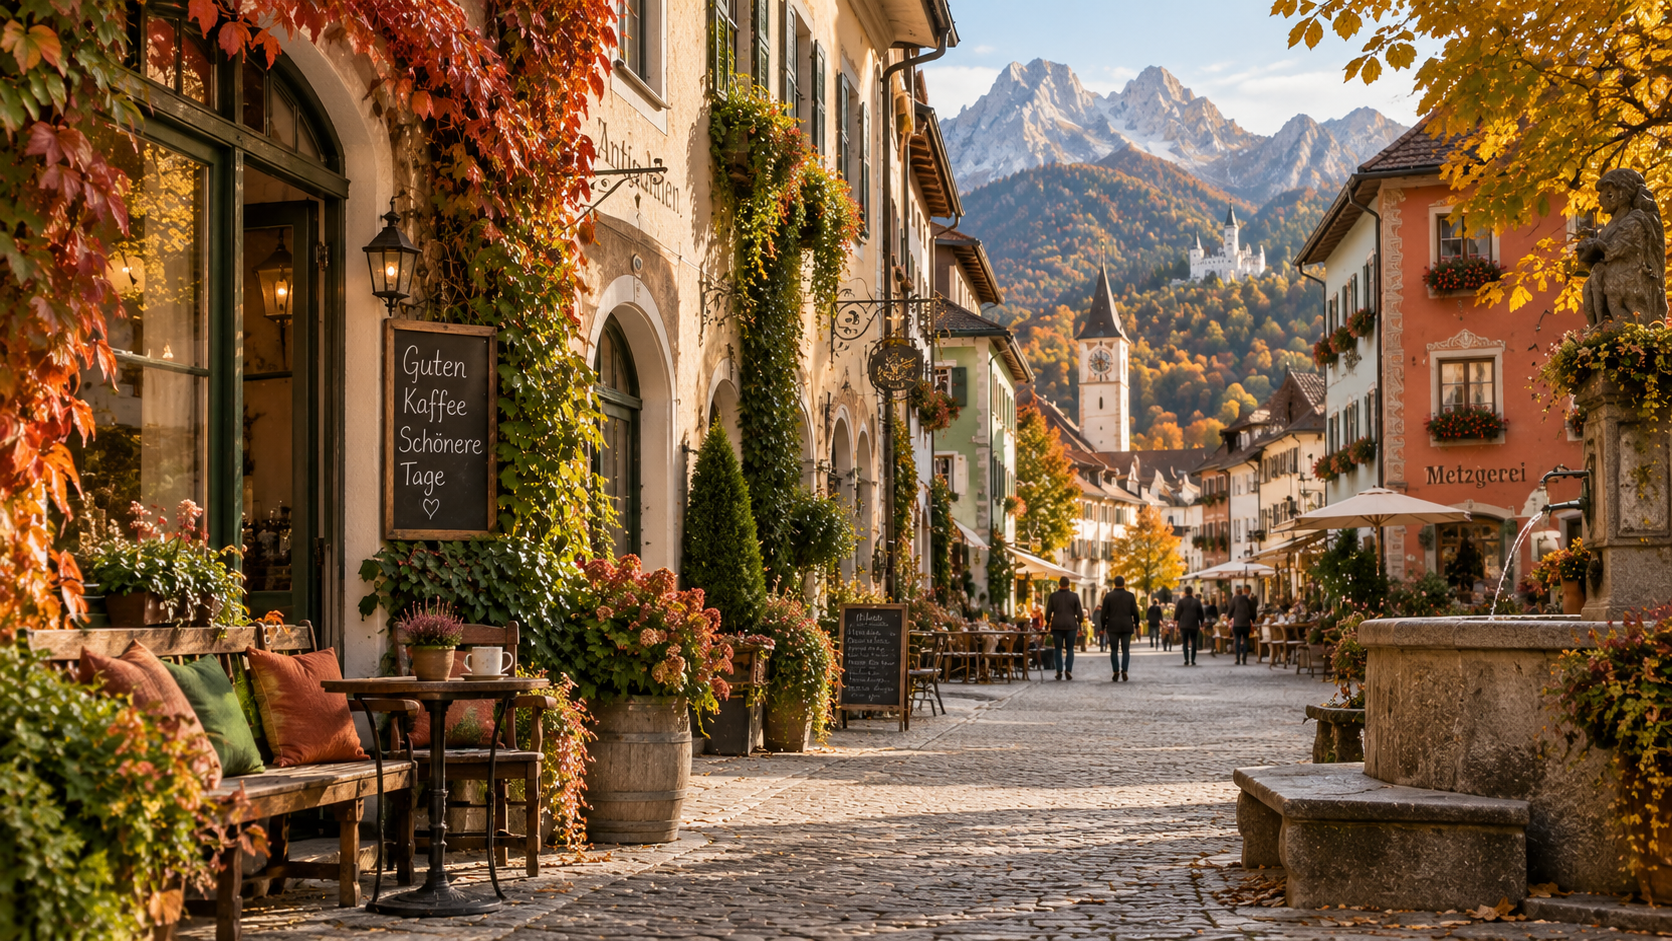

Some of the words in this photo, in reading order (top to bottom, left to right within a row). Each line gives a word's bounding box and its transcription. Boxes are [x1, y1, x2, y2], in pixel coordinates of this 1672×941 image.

[403, 344, 468, 384] Guten
[403, 387, 468, 423] Kaffee
[398, 425, 483, 455] Schönere
[400, 461, 446, 497] Tage
[1425, 462, 1526, 489] Metzgerei
